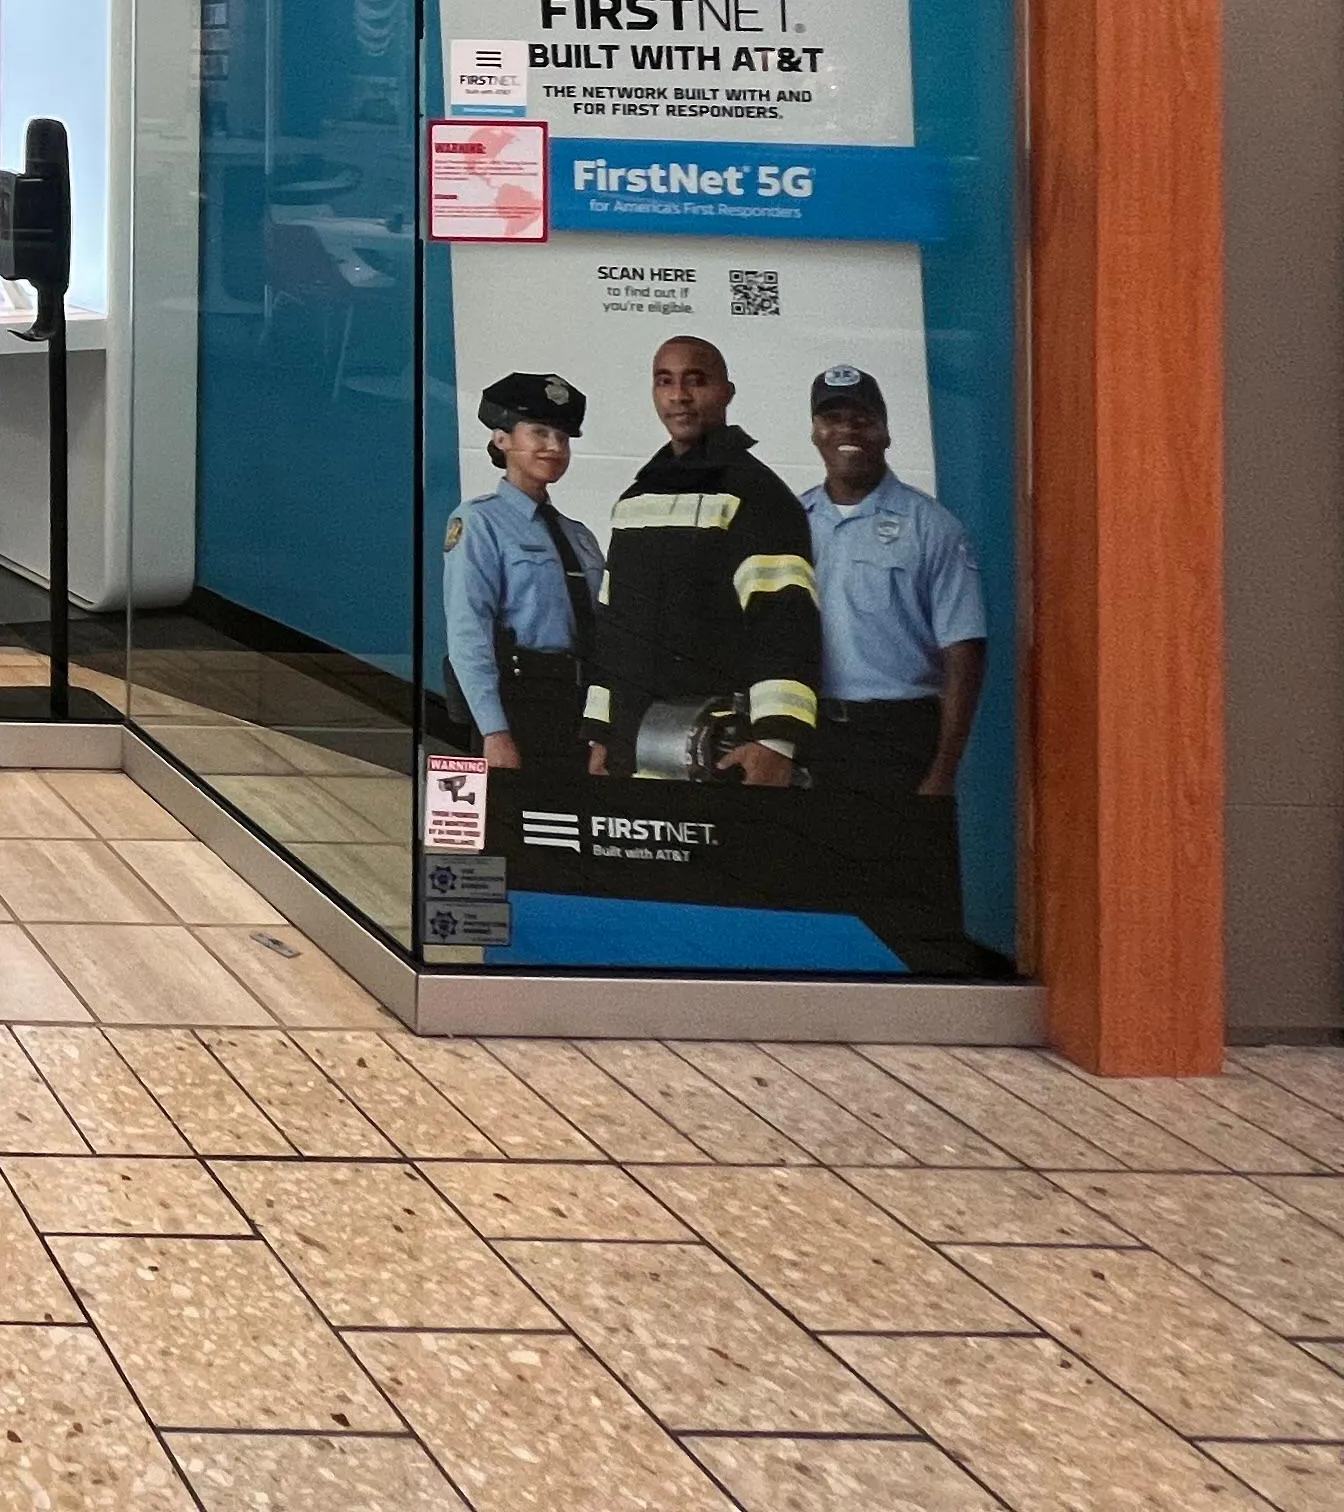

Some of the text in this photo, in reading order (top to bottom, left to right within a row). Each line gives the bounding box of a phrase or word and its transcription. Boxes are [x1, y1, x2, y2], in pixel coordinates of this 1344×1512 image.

[528, 43, 824, 73] BUILT WITH AT&T
[542, 86, 812, 103] THE NETWORK BUILT WITH AND
[573, 102, 783, 120] FOR FIRST RESPONDERS.
[757, 165, 813, 198] 5G
[590, 199, 802, 219] for America's First Responders
[597, 266, 697, 282] SCAN HERE
[607, 286, 689, 298] to find out if
[602, 301, 644, 312] you're
[431, 759, 485, 773] WARNING
[593, 845, 691, 862] Built with AT&T
